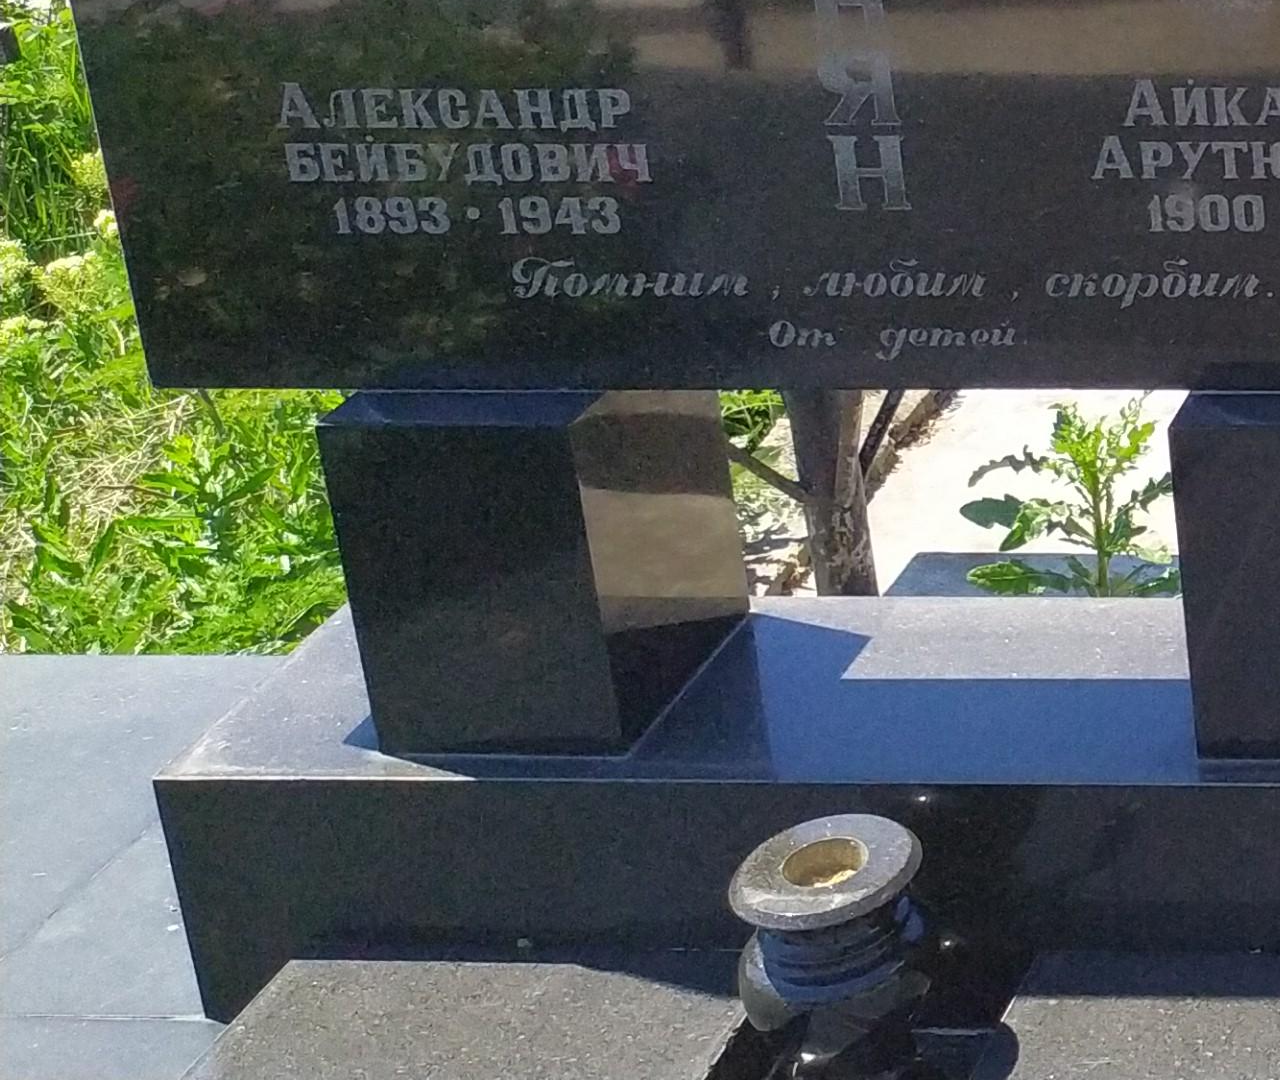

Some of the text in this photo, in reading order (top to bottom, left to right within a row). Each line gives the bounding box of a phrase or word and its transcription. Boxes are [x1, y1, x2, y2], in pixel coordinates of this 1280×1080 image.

[283, 135, 653, 185] БЕЙБУДОВИЧ
[332, 195, 622, 235] 1893 1943
[1147, 194, 1266, 233] 1900
[769, 320, 836, 348] От
